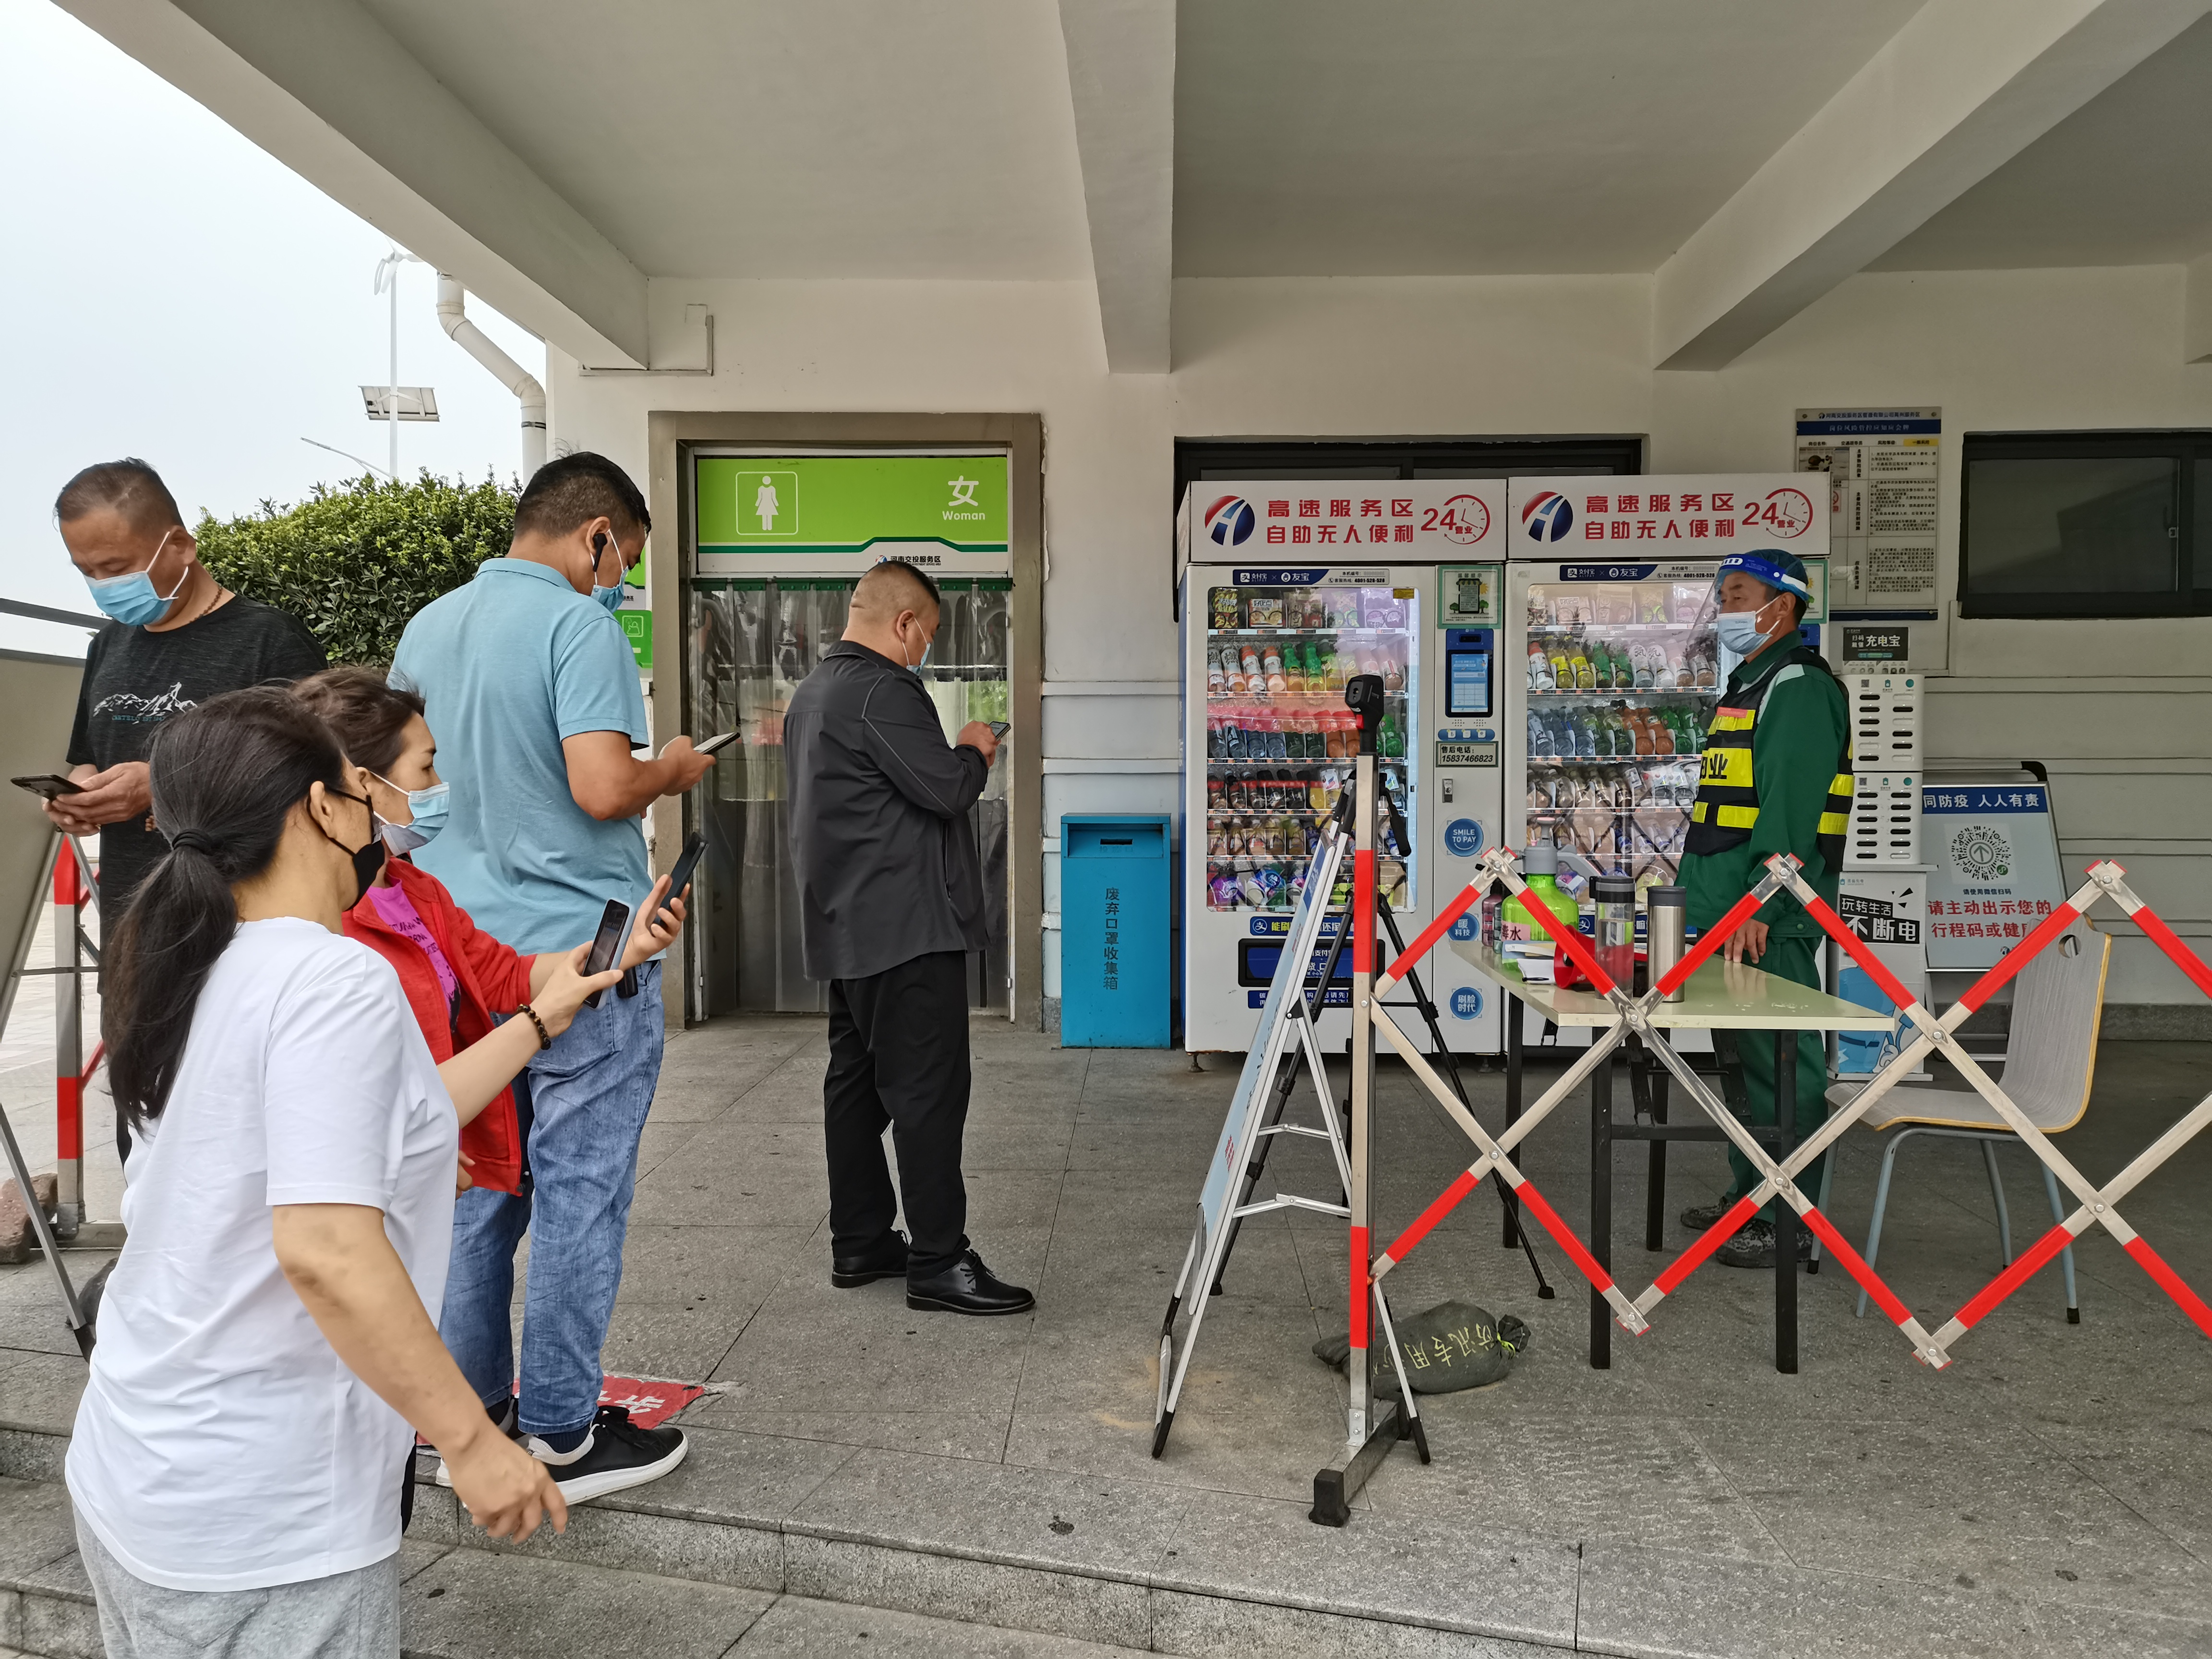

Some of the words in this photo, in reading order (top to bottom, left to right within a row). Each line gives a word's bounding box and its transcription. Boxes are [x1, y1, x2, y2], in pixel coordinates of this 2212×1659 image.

[948, 476, 979, 506] 女
[1268, 499, 1413, 517] 高速服务区
[1586, 493, 1734, 513] 高速服务区
[942, 511, 985, 521] Woman
[1421, 508, 1456, 531] 24
[1742, 502, 1779, 526] 24
[1267, 525, 1413, 543] 自助无人便利
[1455, 526, 1473, 534] 营业
[1585, 519, 1734, 540] 自助无人便利
[1292, 573, 1310, 581] 友宝
[1620, 568, 1638, 577] 友宝
[1866, 635, 1900, 647] 充电宝
[1923, 794, 1969, 808] 同防疫
[1978, 793, 2039, 808] 人人有责
[1841, 898, 1891, 916] 玩转生活
[1928, 900, 2051, 915] 请主动出示您的
[1271, 922, 1291, 931] 能刷
[1458, 919, 1468, 929] 暖
[1842, 914, 1916, 941] 不断电
[1104, 887, 1119, 990] 废弃口罩收集箱
[1458, 994, 1475, 1004] 刷脸
[1458, 1004, 1475, 1013] 时代
